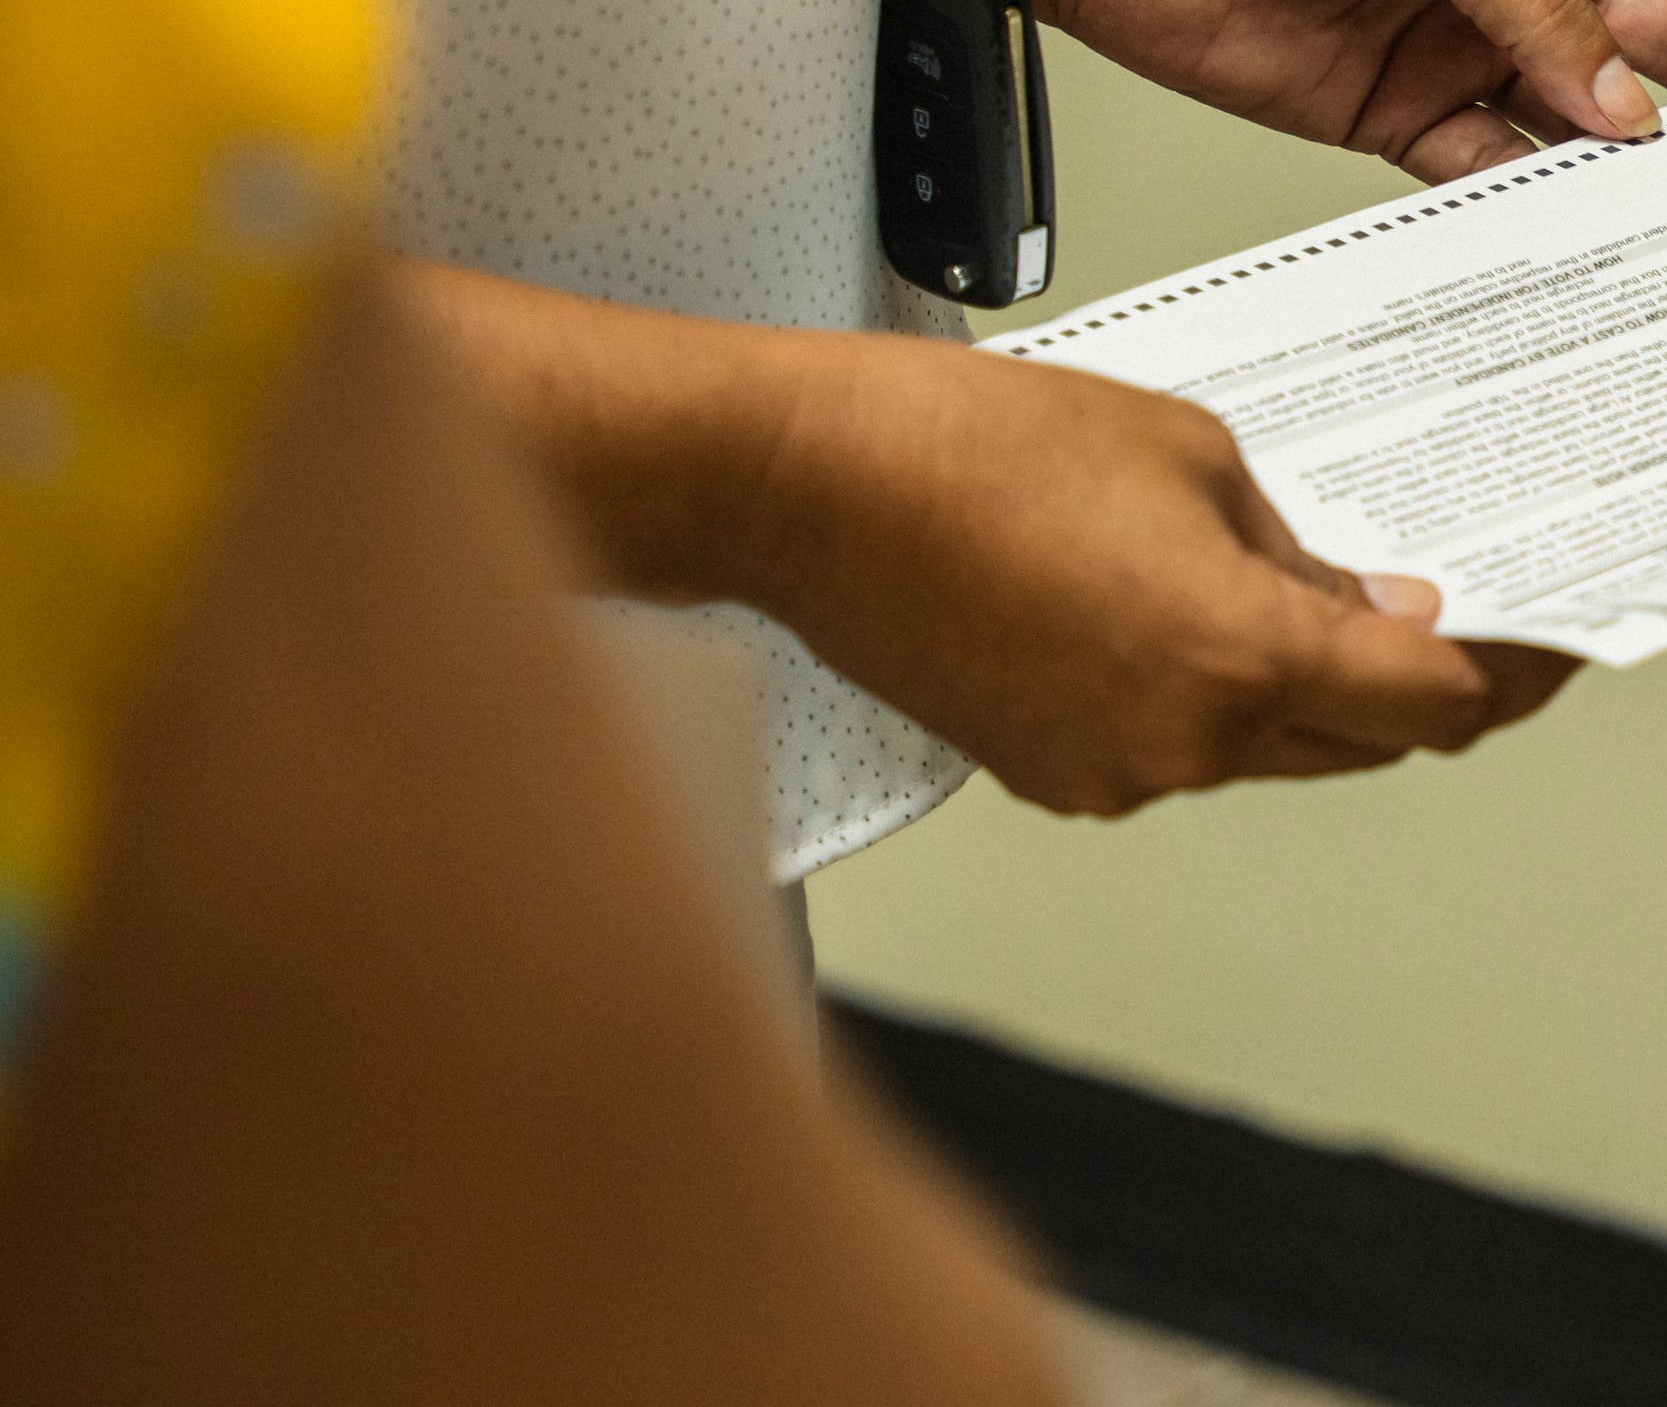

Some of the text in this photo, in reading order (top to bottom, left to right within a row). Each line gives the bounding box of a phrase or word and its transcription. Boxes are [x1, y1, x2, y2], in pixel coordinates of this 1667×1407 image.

[1537, 270, 1576, 289] VOTE
[1424, 290, 1515, 326] INDEPENDENT
[1345, 319, 1429, 352] CANDIDATES
[1587, 323, 1627, 342] CAST
[1542, 338, 1582, 357] VOTE
[1453, 356, 1528, 387] CANDIDACY
